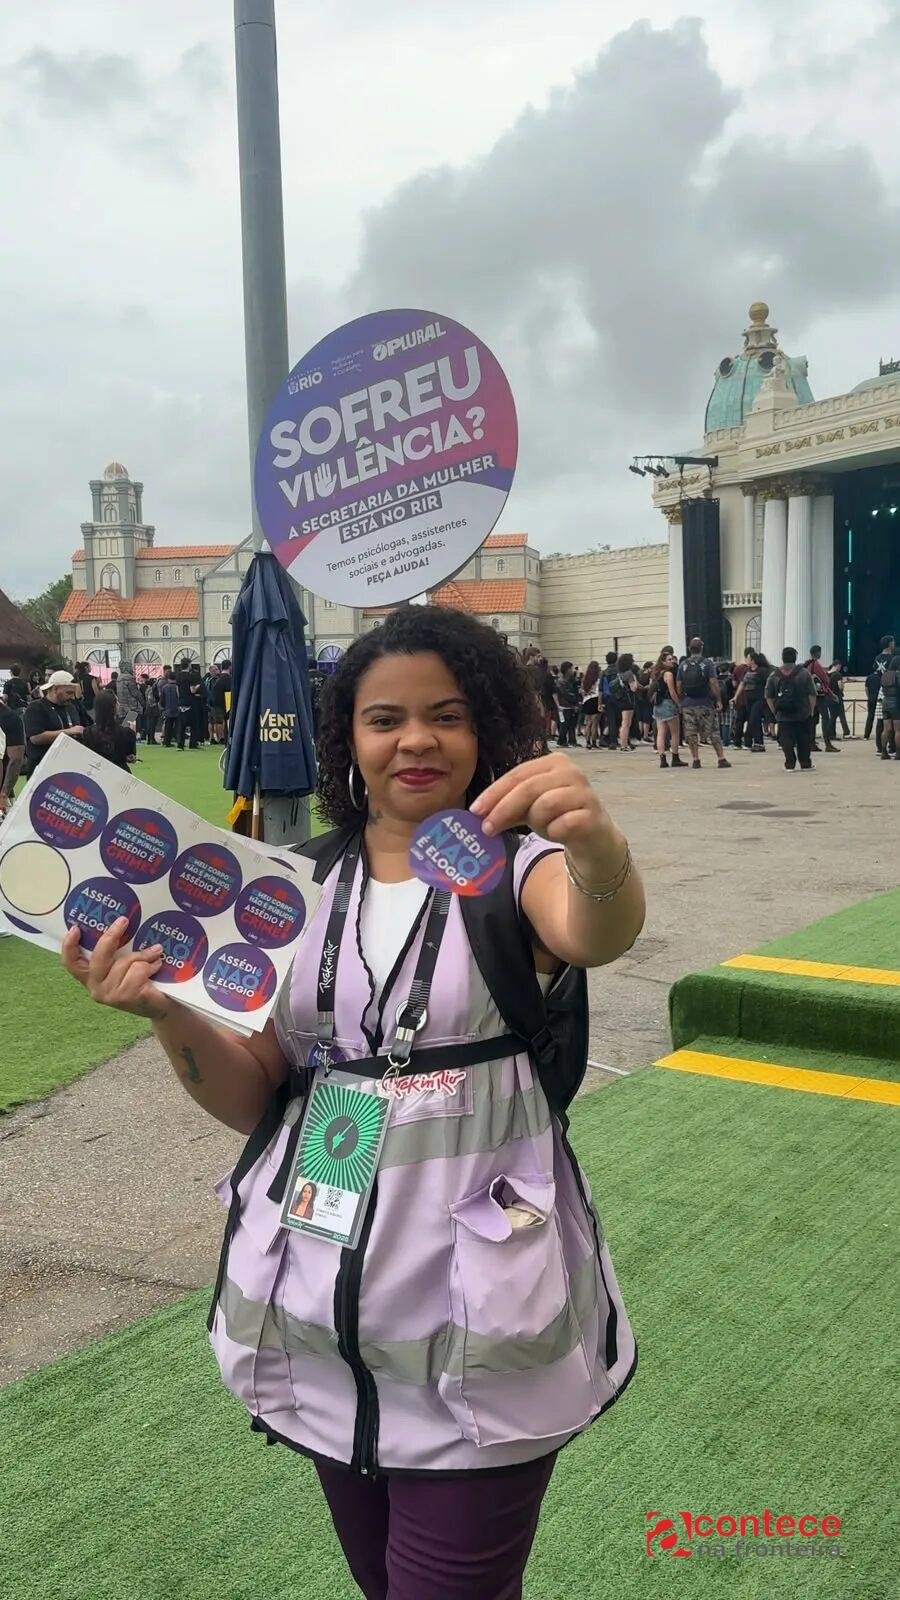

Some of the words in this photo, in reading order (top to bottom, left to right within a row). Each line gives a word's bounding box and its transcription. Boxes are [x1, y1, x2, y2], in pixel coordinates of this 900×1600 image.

[300, 372, 323, 391] RIO
[270, 346, 482, 468] SOFREU
[288, 526, 298, 540] A
[302, 490, 394, 534] SECRETARIA
[397, 483, 420, 499] DA
[424, 455, 495, 492] MULHER
[342, 515, 379, 540] ESTÁ
[381, 508, 406, 526] NO
[411, 496, 440, 516] RIR
[326, 557, 355, 572] Temos
[357, 536, 410, 564] psicólogas,
[412, 518, 467, 542] assistentes
[349, 561, 378, 579] sociais
[380, 558, 387, 566] e
[388, 542, 446, 564] advogadas.
[366, 570, 392, 586] PEÇA
[393, 558, 430, 578] AJUDA!
[56, 788, 69, 798] MEU
[70, 796, 93, 812] CORPO
[40, 801, 76, 822] ASSÉDIO
[77, 818, 84, 828] É
[126, 825, 140, 835] MEU
[141, 832, 164, 846] CORPO
[111, 838, 147, 858] ASSÉDIO
[148, 854, 155, 862] É
[416, 836, 431, 848] É
[425, 846, 467, 886] ELOGIO
[194, 859, 208, 869] MEU
[208, 867, 229, 880] CORPO
[180, 872, 213, 891] ASSÉDIO
[214, 887, 221, 896] É
[258, 892, 272, 901] MEU
[272, 899, 293, 912] CORPO
[70, 907, 78, 918] É
[77, 913, 109, 933] ELOGI
[244, 904, 278, 924] ASSÉDIO
[279, 918, 285, 928] É
[209, 972, 216, 982] É
[217, 978, 254, 998] ELOGIO
